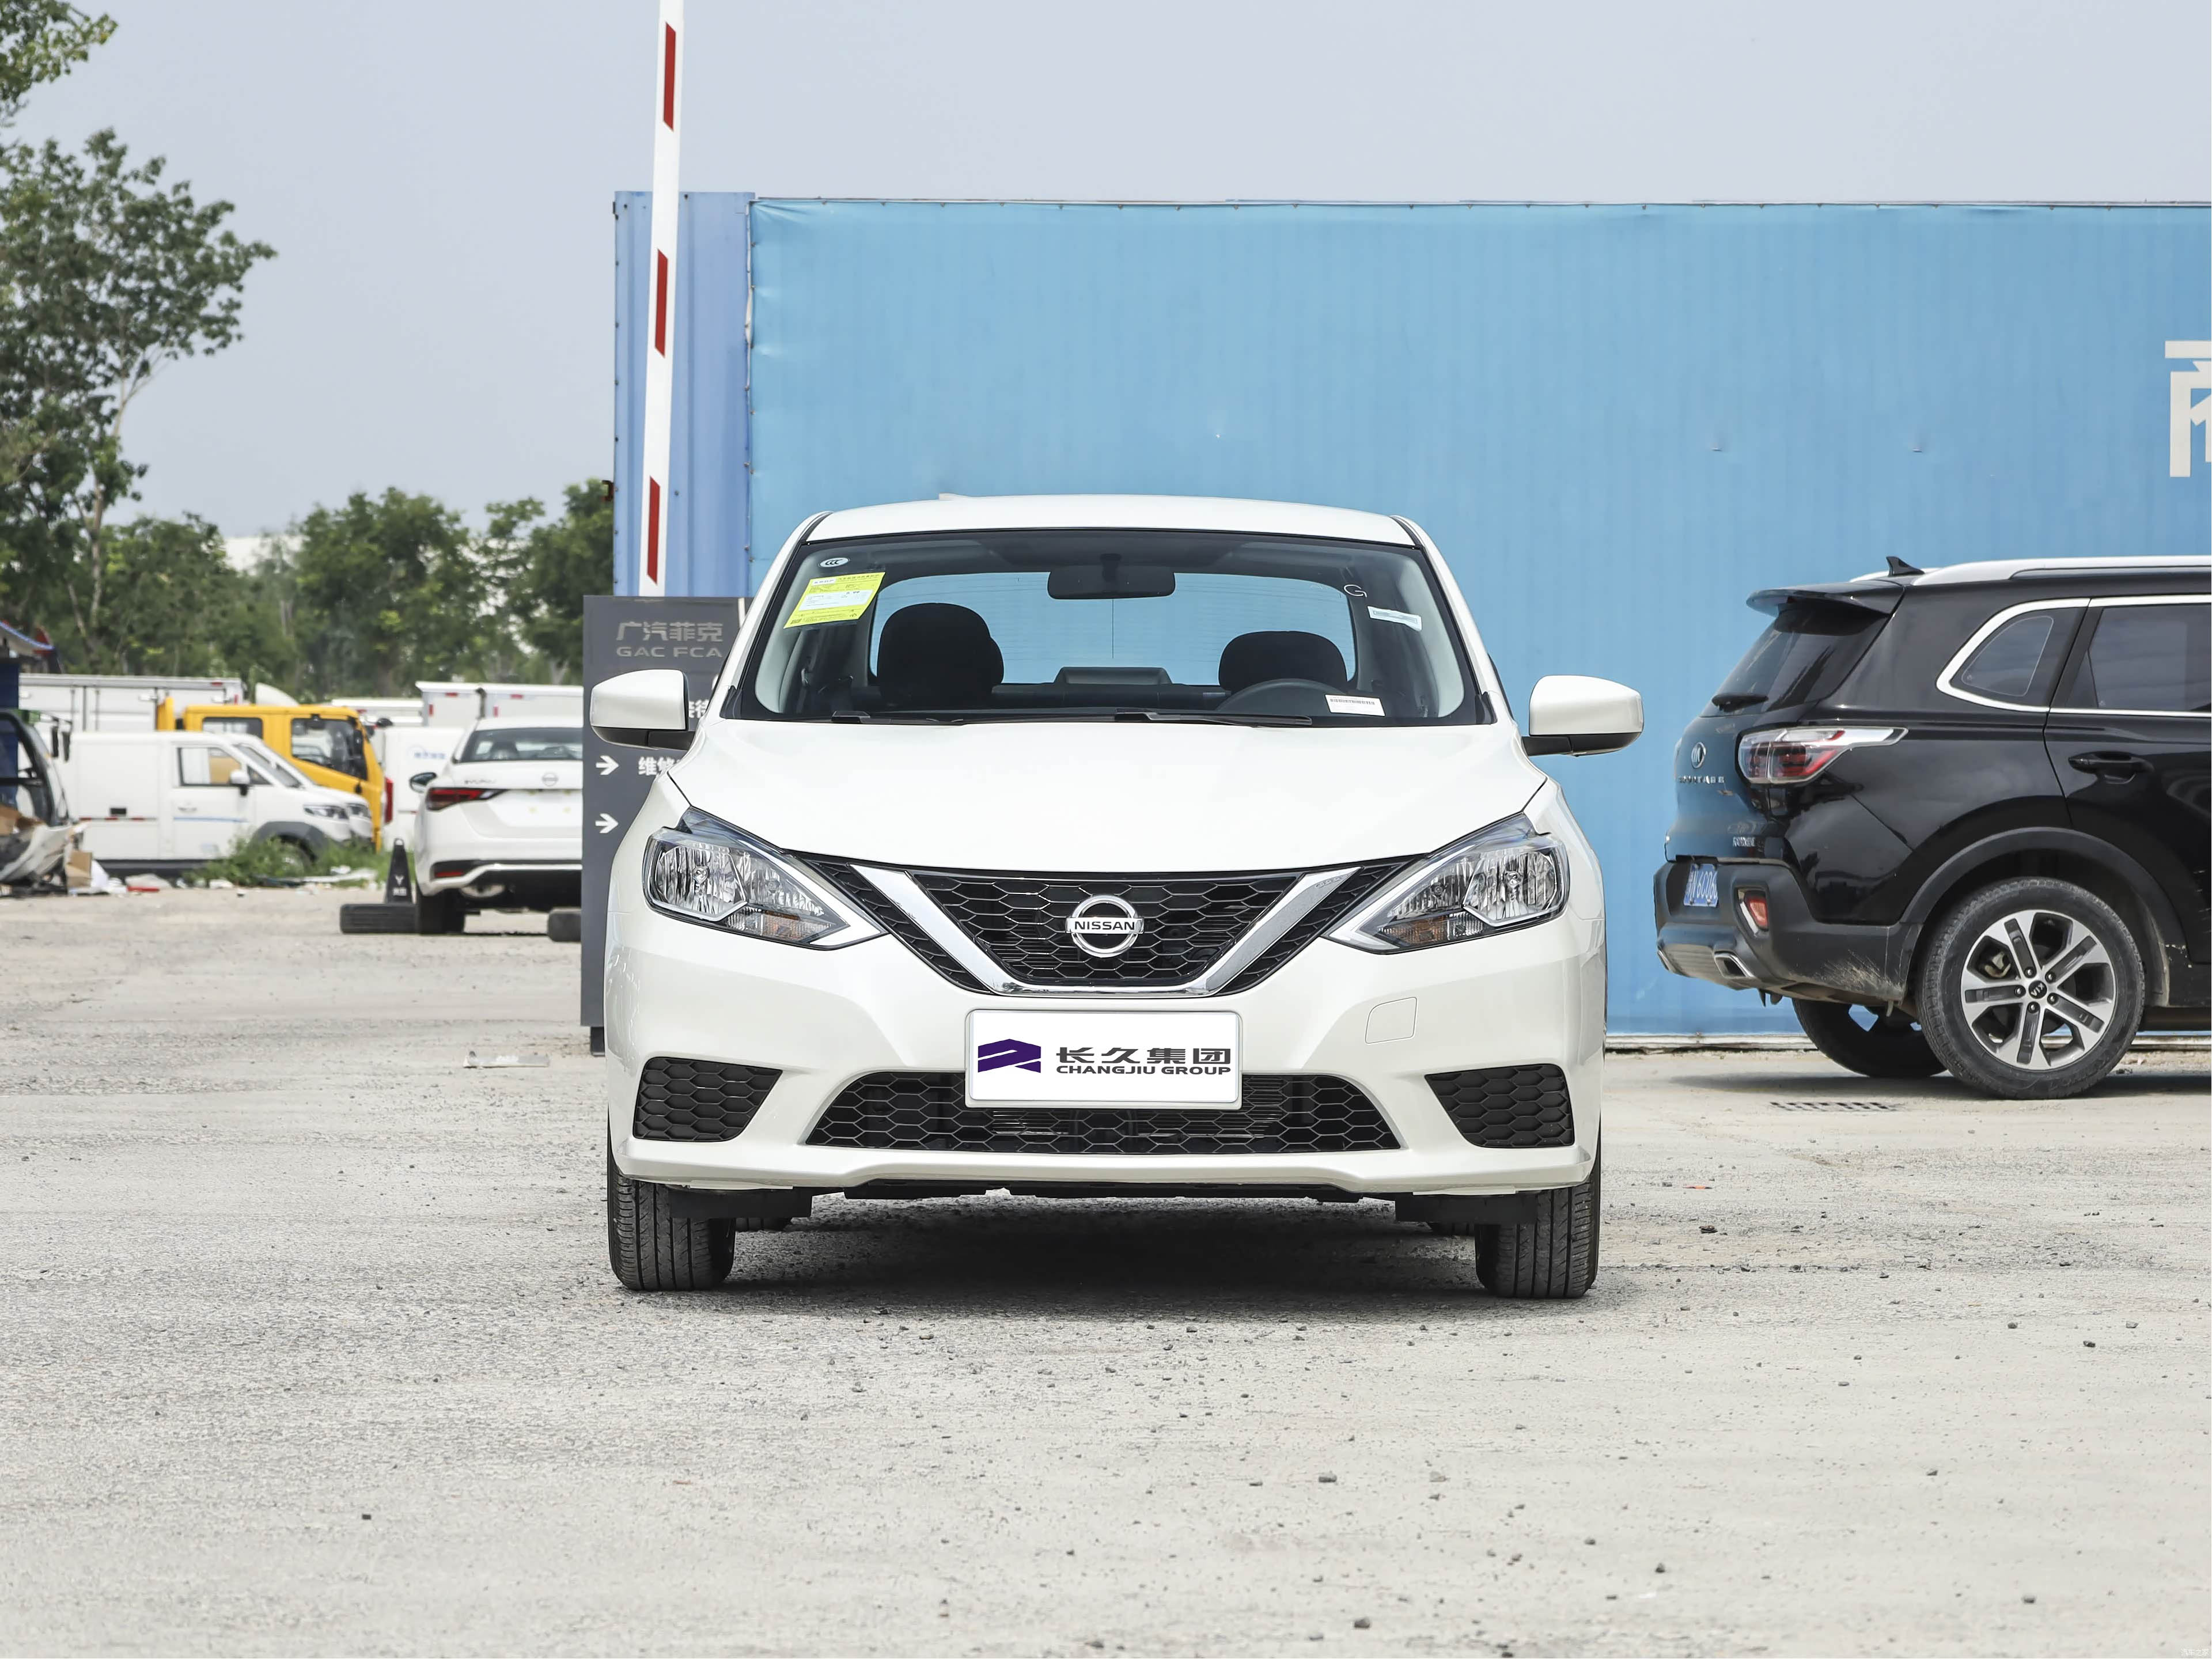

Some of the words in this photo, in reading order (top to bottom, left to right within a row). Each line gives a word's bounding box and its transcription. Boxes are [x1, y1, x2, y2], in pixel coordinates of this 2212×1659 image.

[616, 621, 724, 642] 广汽菲克
[616, 646, 665, 657] GAC
[673, 646, 724, 657] FCA
[638, 756, 681, 775] 维修
[1074, 921, 1135, 930] NISSAN
[1056, 1047, 1231, 1065] 长久集团
[1056, 1065, 1156, 1074] CHANGJIU
[1161, 1066, 1231, 1075] GROUP
